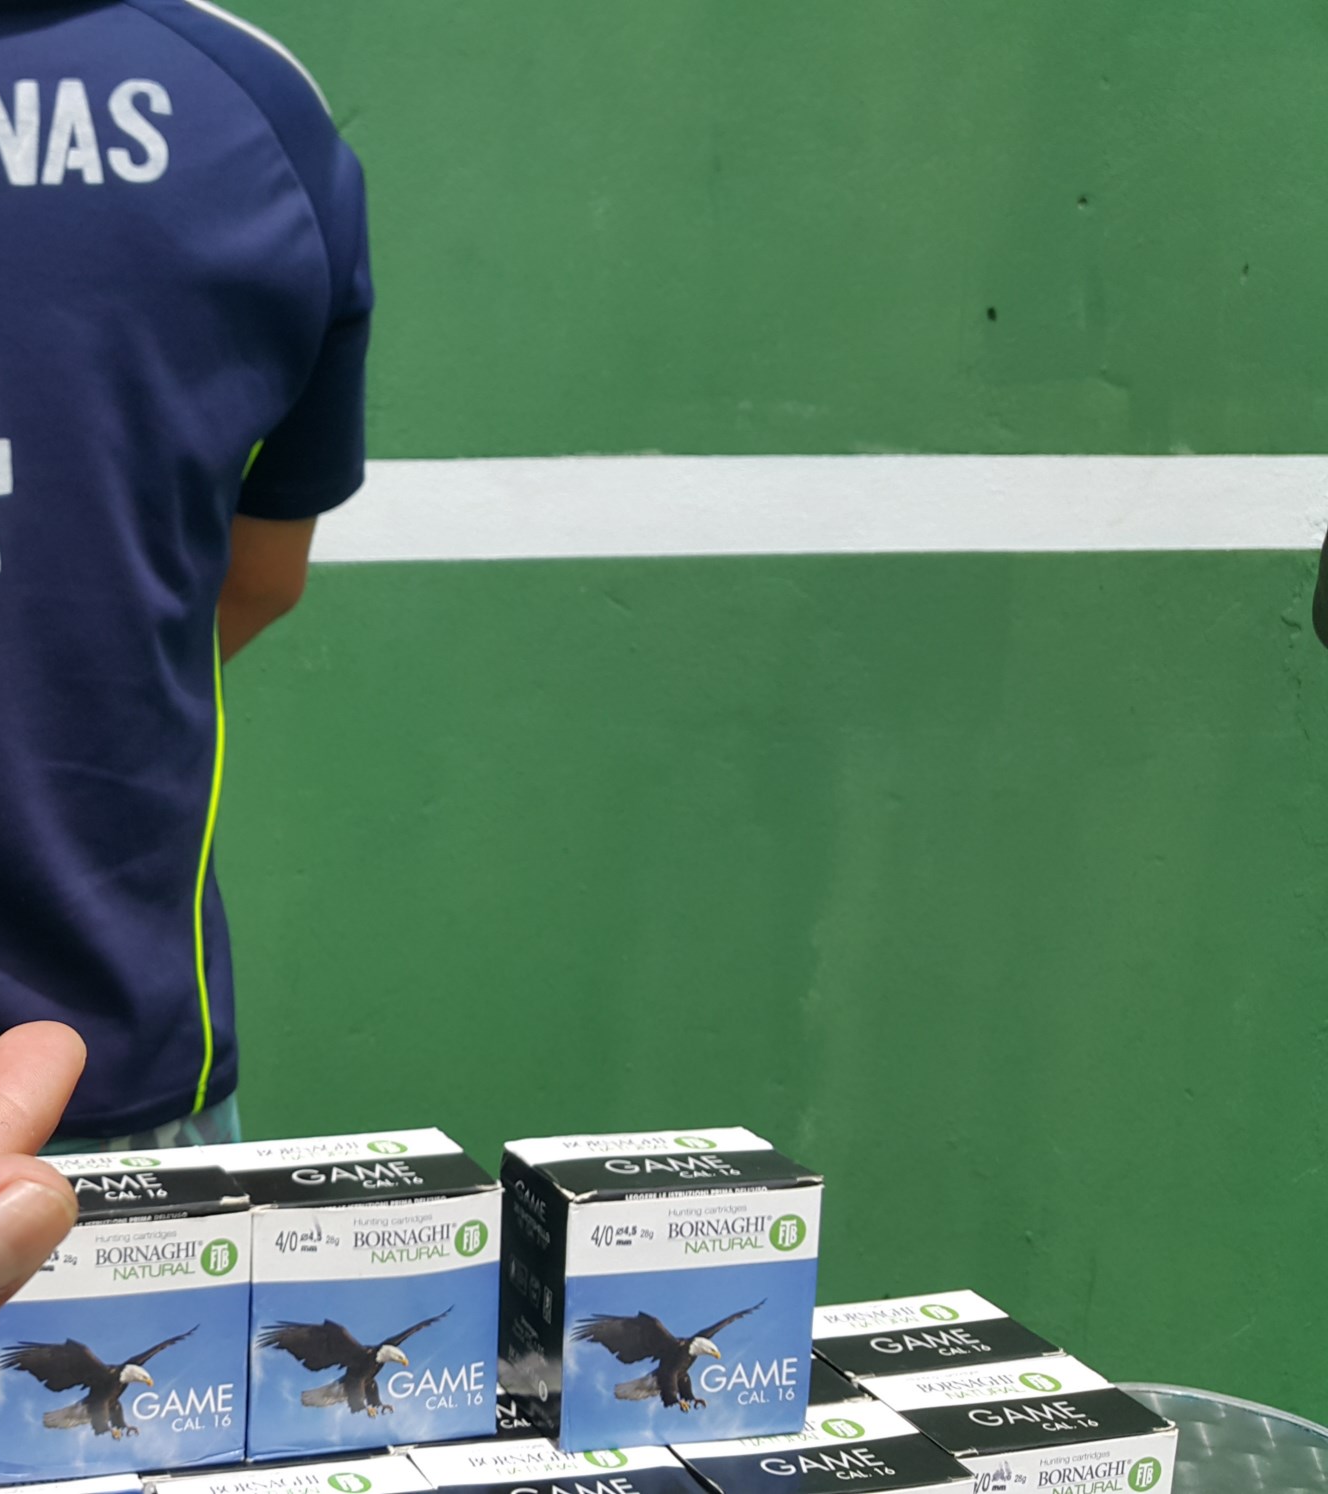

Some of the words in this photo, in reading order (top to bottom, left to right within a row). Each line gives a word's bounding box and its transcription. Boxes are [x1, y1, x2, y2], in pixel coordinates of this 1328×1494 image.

[291, 1160, 417, 1185] GAME
[604, 1154, 732, 1175] GAME
[679, 1170, 717, 1180] CAL.
[722, 1168, 743, 1177] 16
[73, 1172, 163, 1193] AME
[362, 1179, 399, 1189] CAL.
[404, 1176, 424, 1186] 16
[104, 1189, 142, 1200] CAL.
[147, 1188, 169, 1198] 16
[353, 1217, 388, 1229] Hunting
[390, 1213, 433, 1226] cartridges
[667, 1206, 702, 1218] Hunting
[704, 1204, 748, 1216] cartridges
[95, 1232, 131, 1244] Hunting
[132, 1229, 177, 1241] cartridges
[352, 1223, 452, 1249] BORNAGHI
[591, 1225, 614, 1248] 4/0
[667, 1215, 767, 1239] BORNAGHI
[275, 1231, 298, 1254] 4/0
[684, 1236, 764, 1255] NATURAL
[95, 1241, 198, 1266] BORNAGHI
[370, 1244, 451, 1265] NATURAL
[113, 1261, 196, 1281] NATURAL
[869, 1328, 981, 1353] GAME
[938, 1347, 971, 1357] CAL.
[972, 1343, 991, 1353] 16
[387, 1361, 485, 1399] GAME
[700, 1358, 798, 1393] GAME
[132, 1383, 234, 1420] GAME
[425, 1396, 458, 1411] CAL.
[466, 1391, 484, 1406] 16
[737, 1389, 770, 1406] CAL.
[778, 1387, 796, 1401] 16
[172, 1416, 206, 1433] CAL.
[213, 1413, 232, 1428] 16
[968, 1400, 1087, 1427] GAME
[1041, 1421, 1077, 1432] CAL.
[1079, 1418, 1099, 1429] 16
[760, 1448, 885, 1476] GAME
[1039, 1456, 1070, 1466] Hunting
[1072, 1450, 1111, 1462] cartridges
[835, 1469, 873, 1481] CAL.
[873, 1467, 896, 1477] 16
[1038, 1460, 1126, 1487] BORNAGHI
[1052, 1477, 1123, 1494] NATURAL
